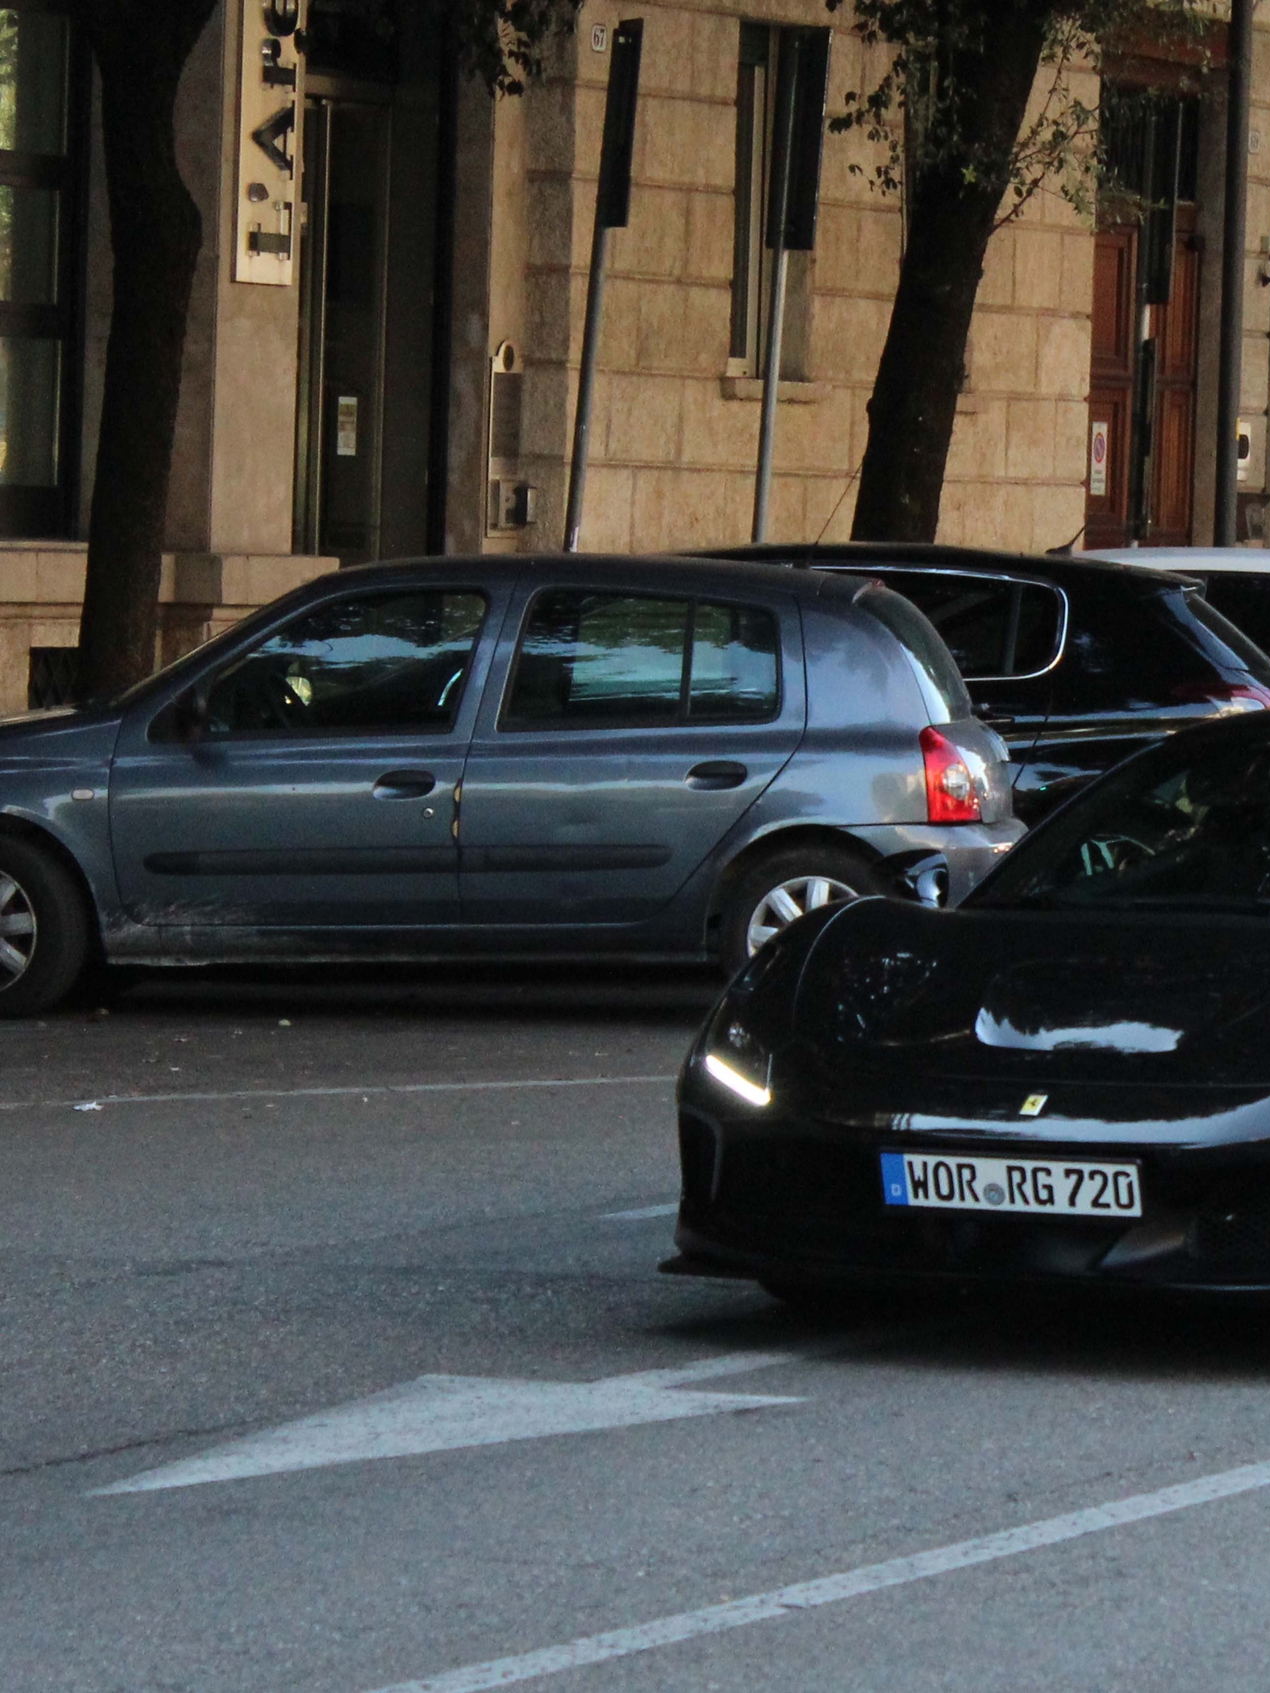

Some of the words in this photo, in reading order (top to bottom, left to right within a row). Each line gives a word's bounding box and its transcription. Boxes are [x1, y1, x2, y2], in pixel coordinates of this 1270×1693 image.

[906, 1160, 980, 1202] WOR
[1005, 1164, 1055, 1206] RG
[1063, 1167, 1136, 1210] 720
